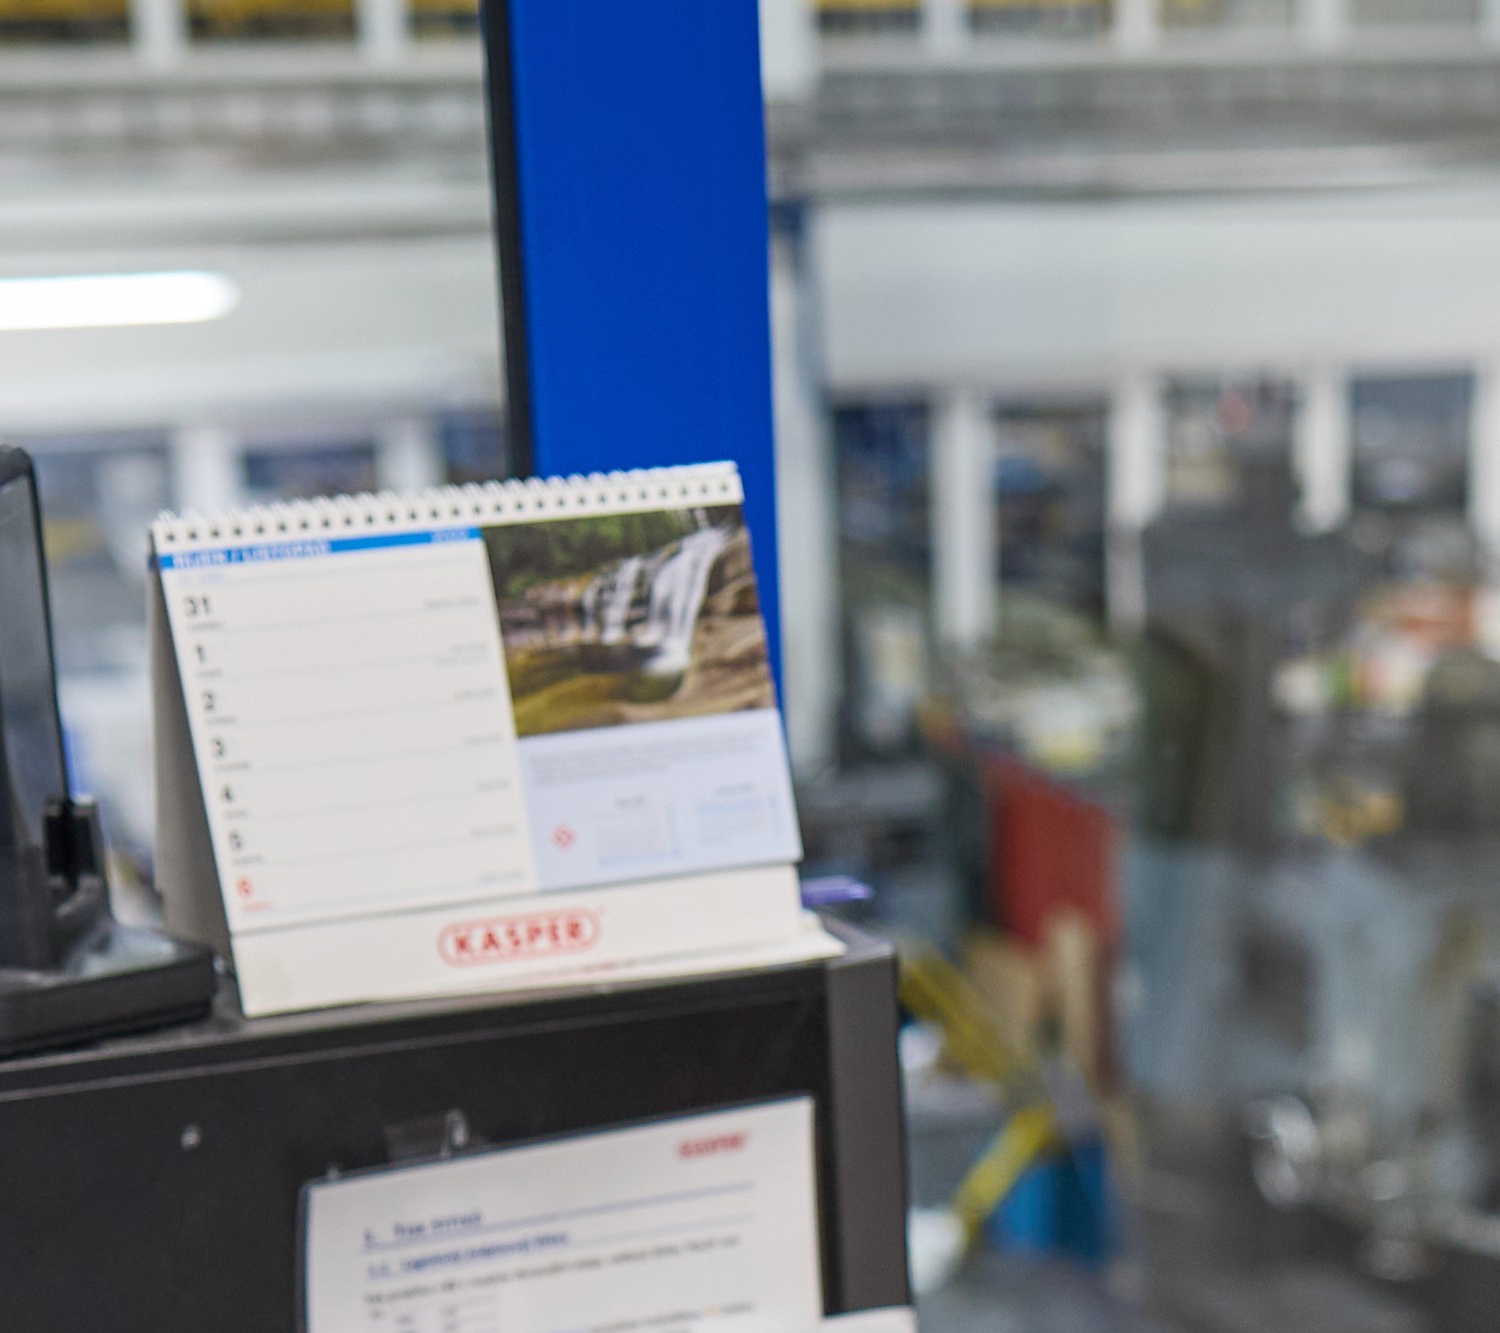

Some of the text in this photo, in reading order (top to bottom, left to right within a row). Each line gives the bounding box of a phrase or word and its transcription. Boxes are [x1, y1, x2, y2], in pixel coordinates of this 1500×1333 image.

[184, 595, 211, 618] 31
[195, 644, 206, 663] 1
[202, 691, 218, 713] 2
[211, 737, 227, 759] 3
[219, 784, 234, 804] 4
[228, 829, 244, 851] 5
[237, 876, 253, 898] 6
[453, 916, 588, 959] KASPER
